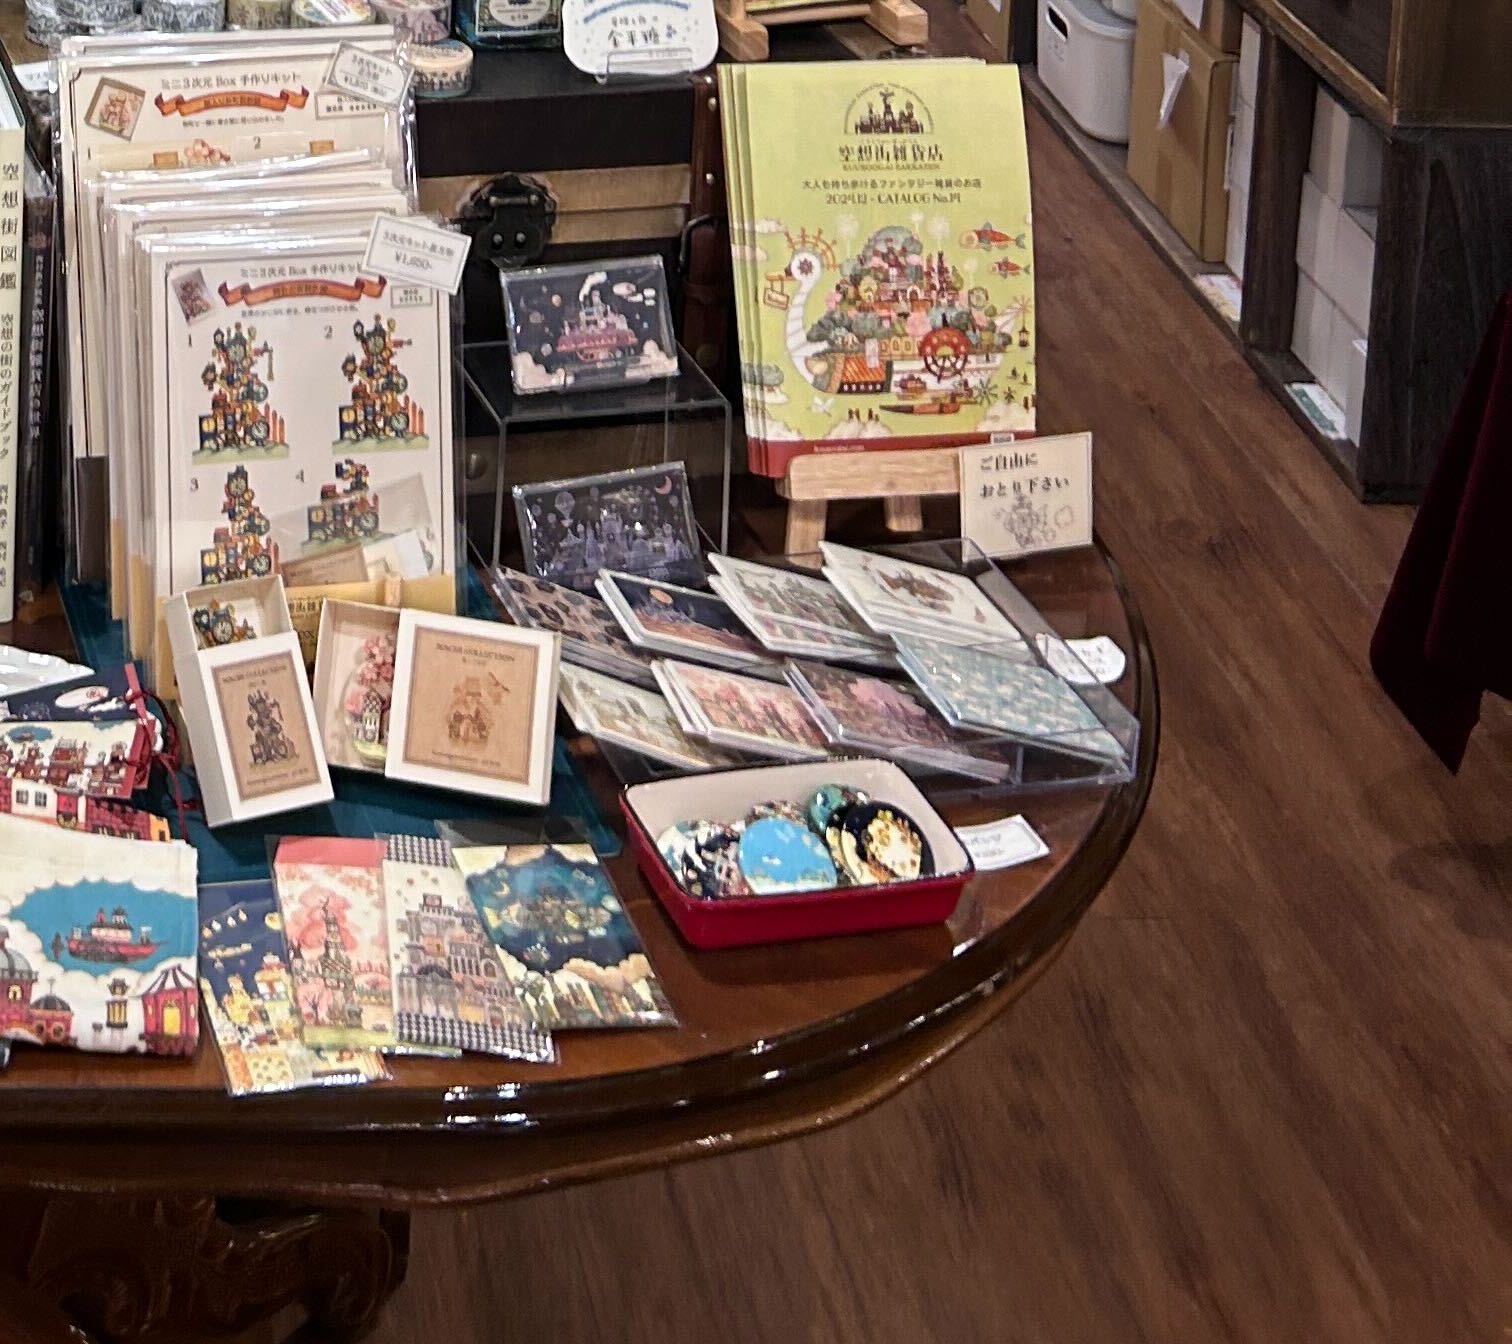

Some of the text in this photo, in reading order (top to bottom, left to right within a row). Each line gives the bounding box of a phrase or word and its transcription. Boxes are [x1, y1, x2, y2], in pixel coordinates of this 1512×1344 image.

[215, 74, 237, 87] Box
[253, 136, 262, 149] 2
[877, 191, 931, 205] CATALOG
[0, 162, 19, 291] 空想街図鑑
[0, 313, 15, 461] 空想の街のガイドブック
[979, 451, 1039, 473] ご自由に
[979, 476, 1072, 500] おとり下さい
